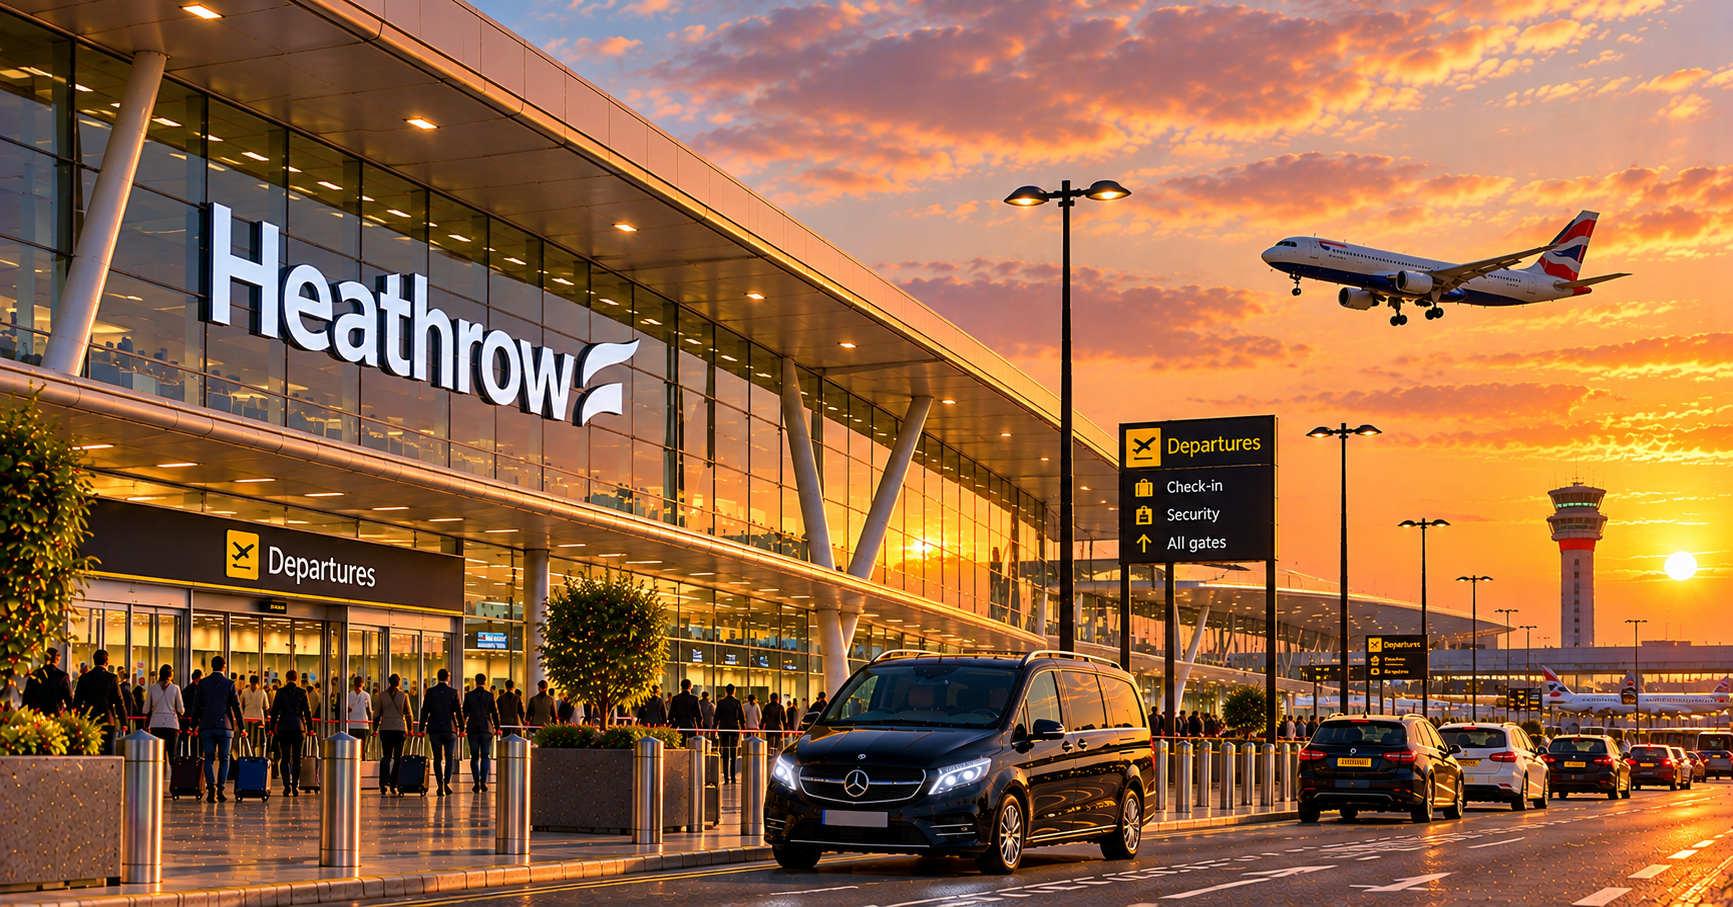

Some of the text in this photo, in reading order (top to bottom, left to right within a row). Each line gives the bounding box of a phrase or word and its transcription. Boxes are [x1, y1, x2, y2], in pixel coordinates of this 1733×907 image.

[208, 201, 576, 422] Heathrow
[1167, 436, 1261, 457] Departures
[1166, 479, 1223, 493] Check-in
[1166, 507, 1220, 522] Security
[1166, 536, 1227, 552] All gates
[268, 545, 376, 588] Departures
